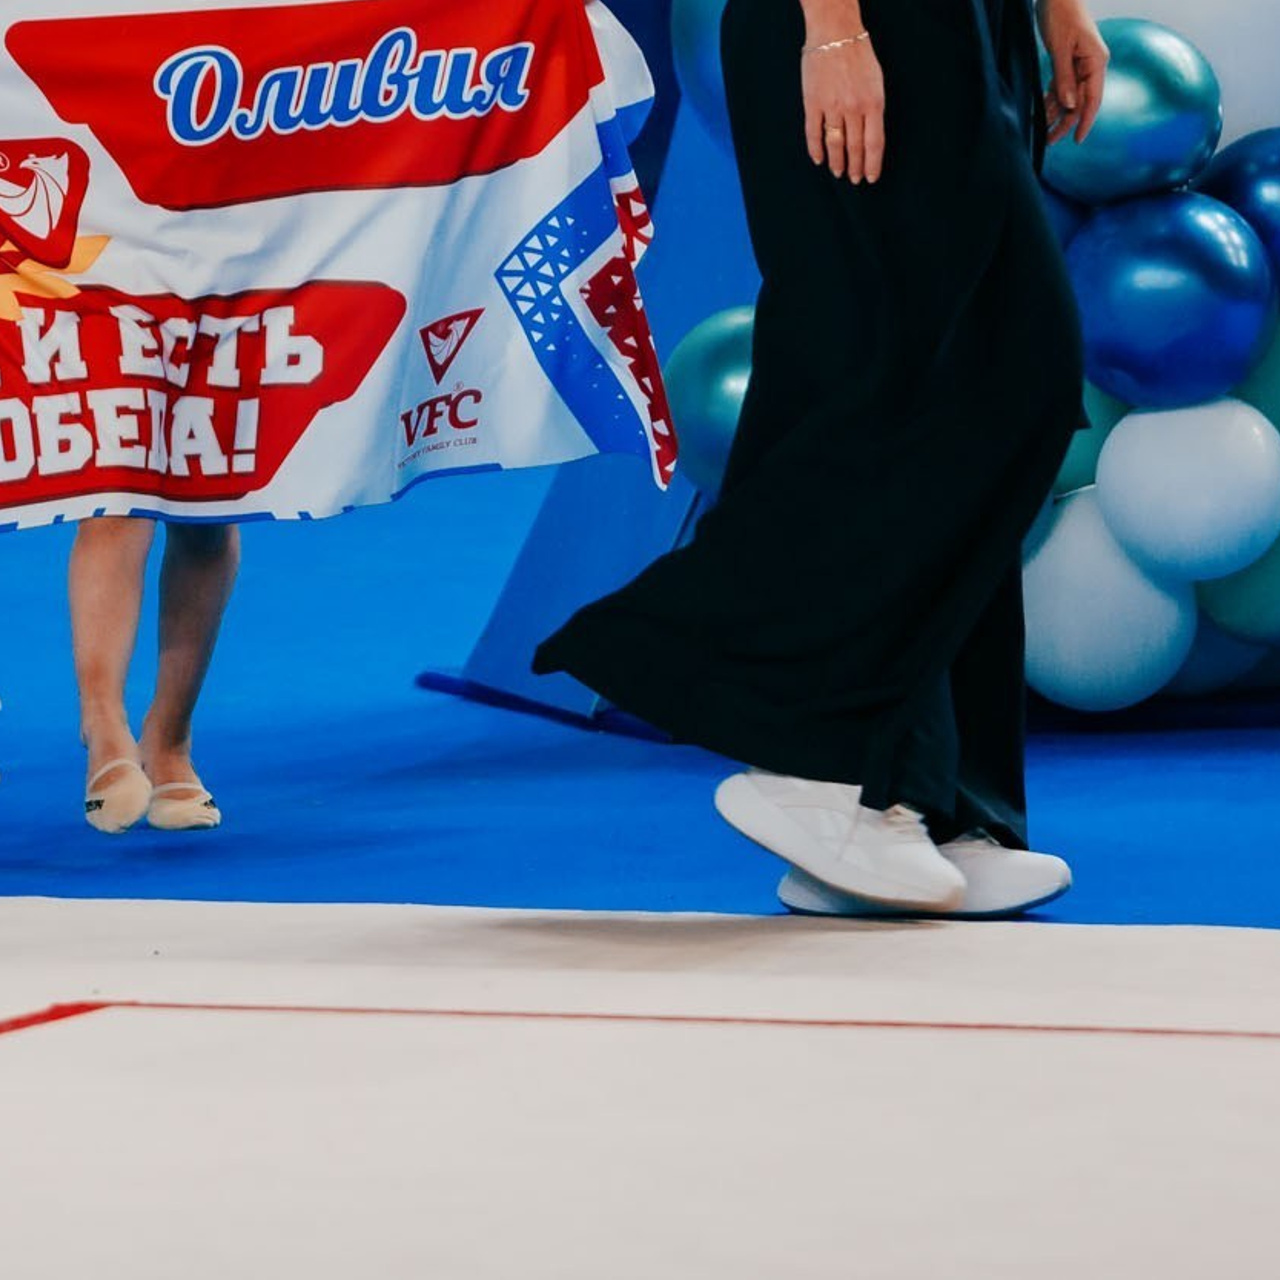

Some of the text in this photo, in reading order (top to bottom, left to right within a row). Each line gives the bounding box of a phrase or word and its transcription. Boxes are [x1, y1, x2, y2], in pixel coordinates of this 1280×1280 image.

[154, 27, 535, 147] Оливия
[19, 305, 88, 383] И
[108, 304, 324, 388] ЕСТЬ
[400, 389, 482, 447] VFC
